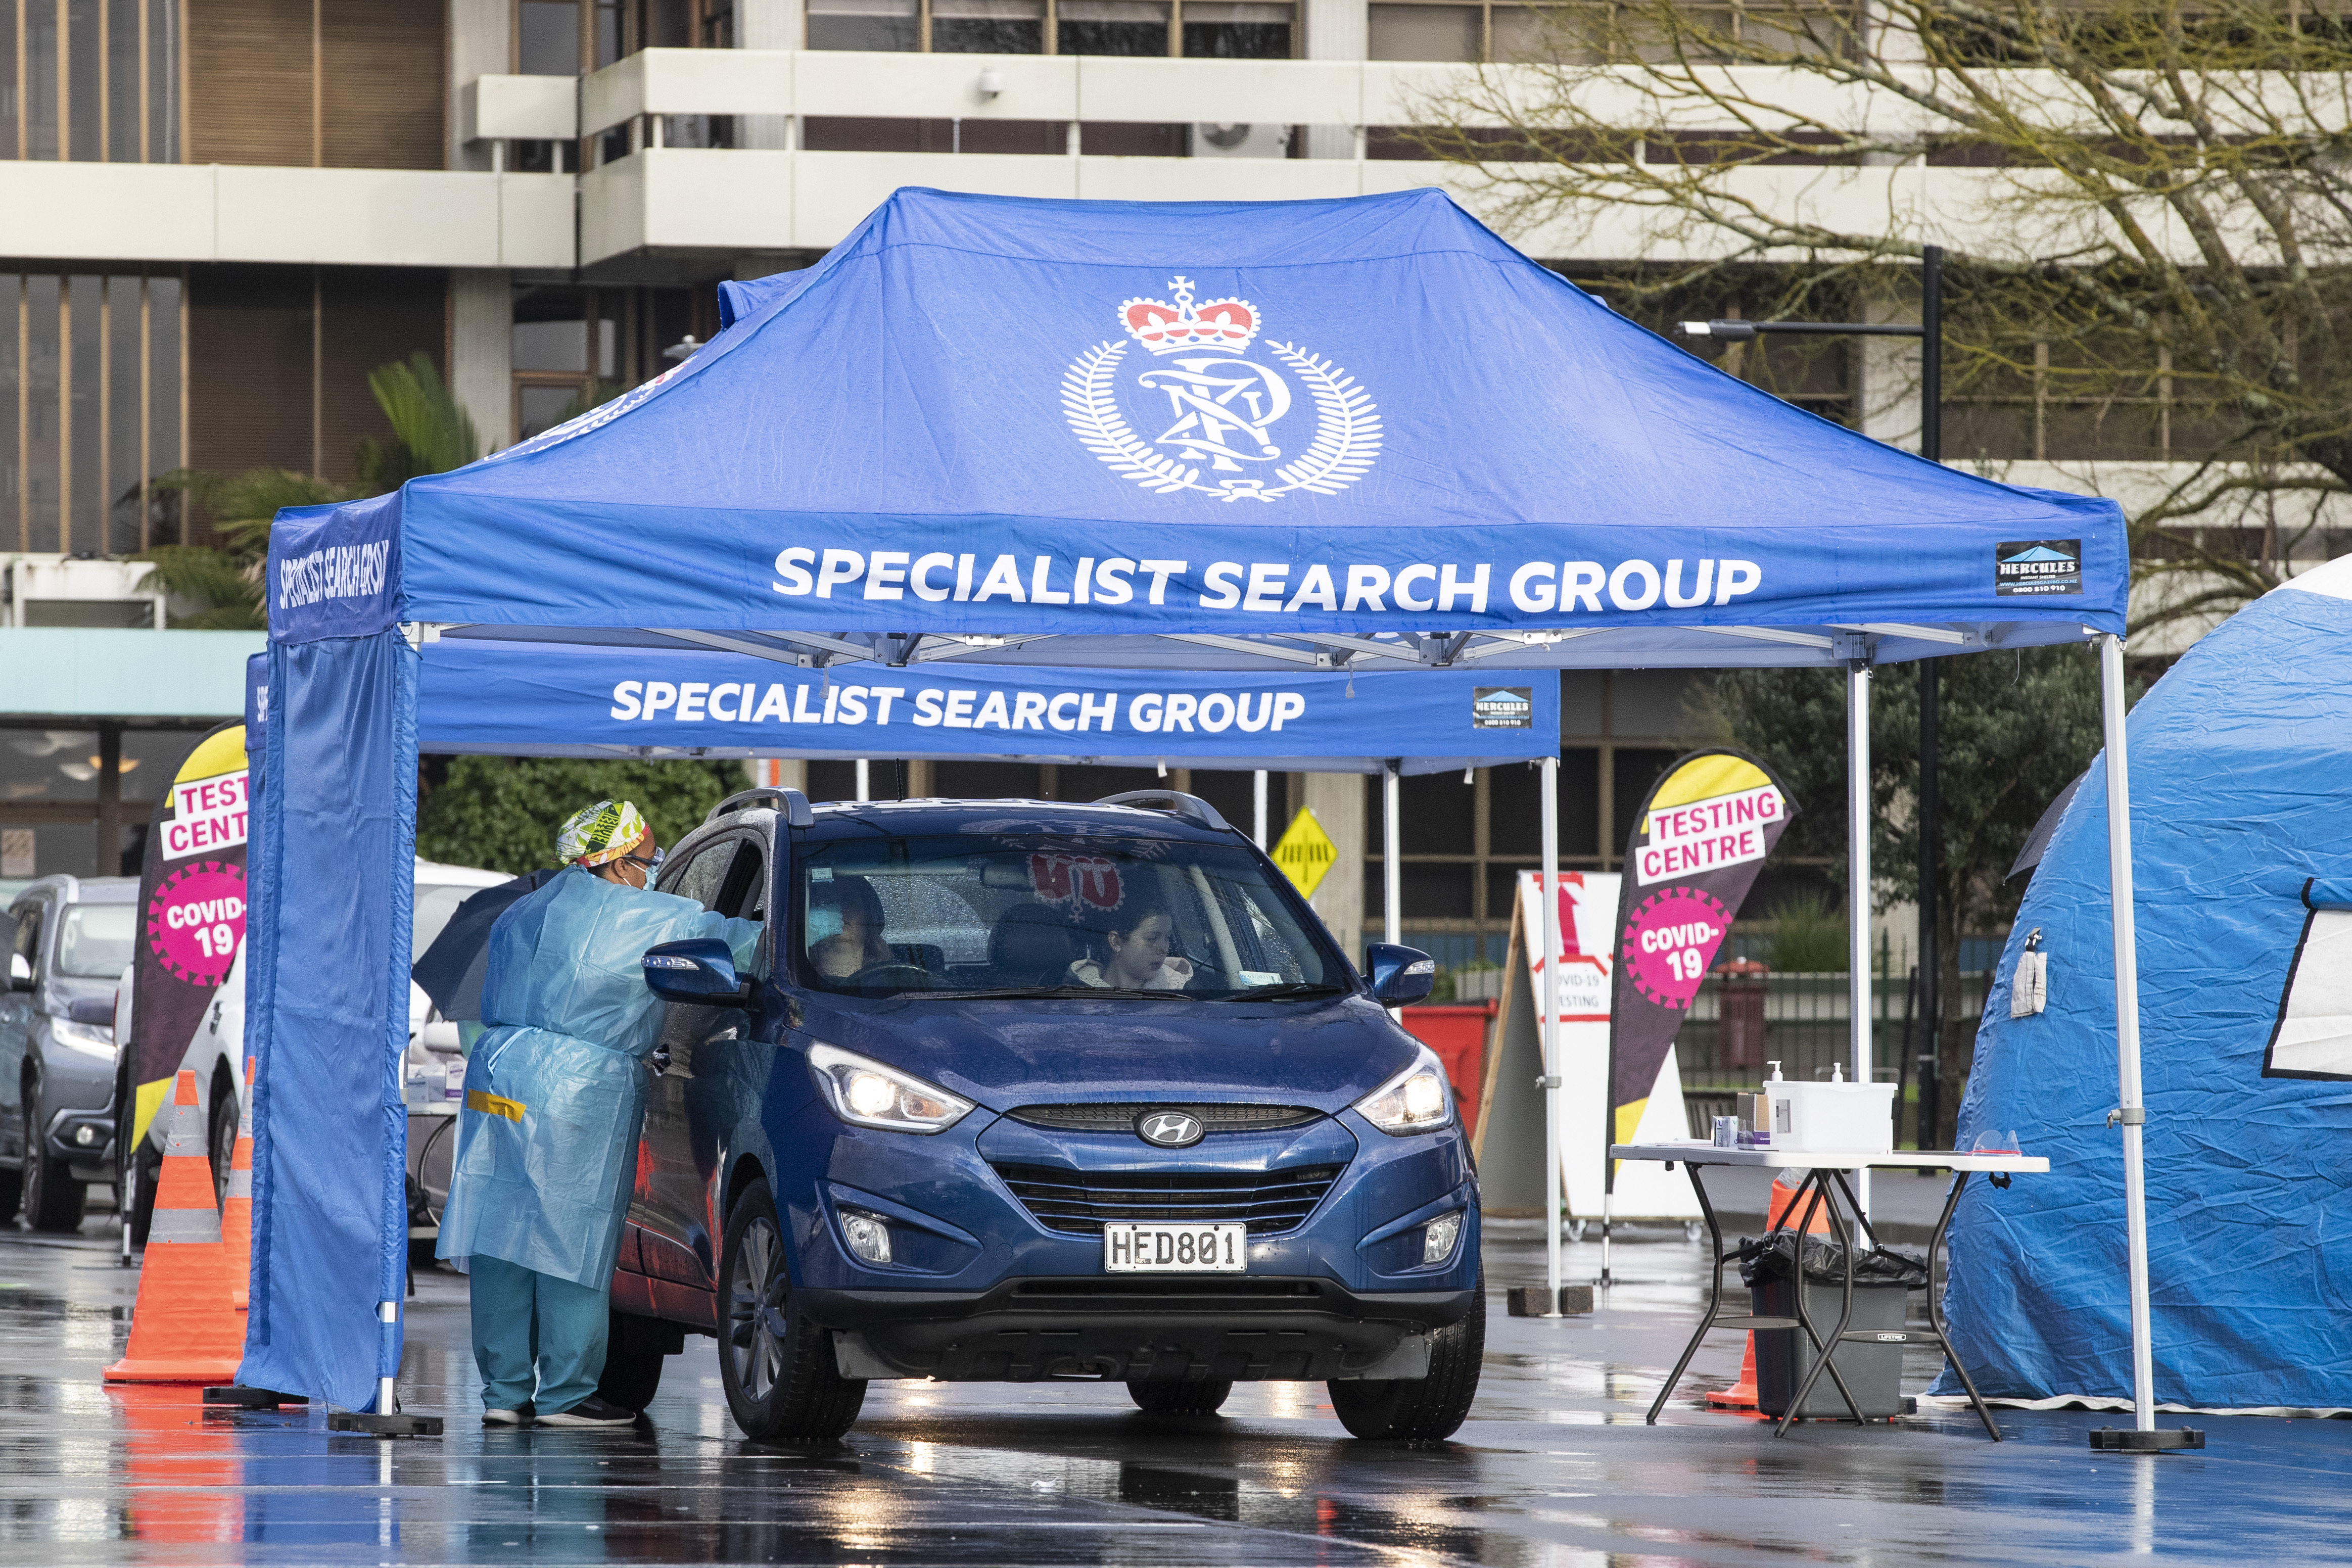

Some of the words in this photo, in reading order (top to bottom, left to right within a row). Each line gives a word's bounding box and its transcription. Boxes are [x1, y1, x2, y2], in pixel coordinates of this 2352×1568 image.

[279, 550, 323, 609] SPECIALIST
[324, 545, 360, 600] SEARCH
[773, 547, 1188, 605] SPECIALIST
[1199, 561, 1491, 613] SEARCH
[1510, 559, 1762, 613] GROUP
[2000, 561, 2075, 575] HERCULES
[610, 680, 905, 726] SPECIALIST
[913, 689, 1118, 731] SEARCH
[1130, 693, 1305, 733] GROUP
[1476, 702, 1529, 711] HERCULES
[1656, 792, 1776, 840] TESTING
[1644, 830, 1755, 877] CENTRE
[194, 924, 233, 957] 19
[1641, 922, 1719, 953] COVID-
[1559, 974, 1600, 986] VID-19
[1666, 948, 1703, 981] 19
[1559, 994, 1600, 1008] ESTING
[1112, 1231, 1235, 1264] HED801
